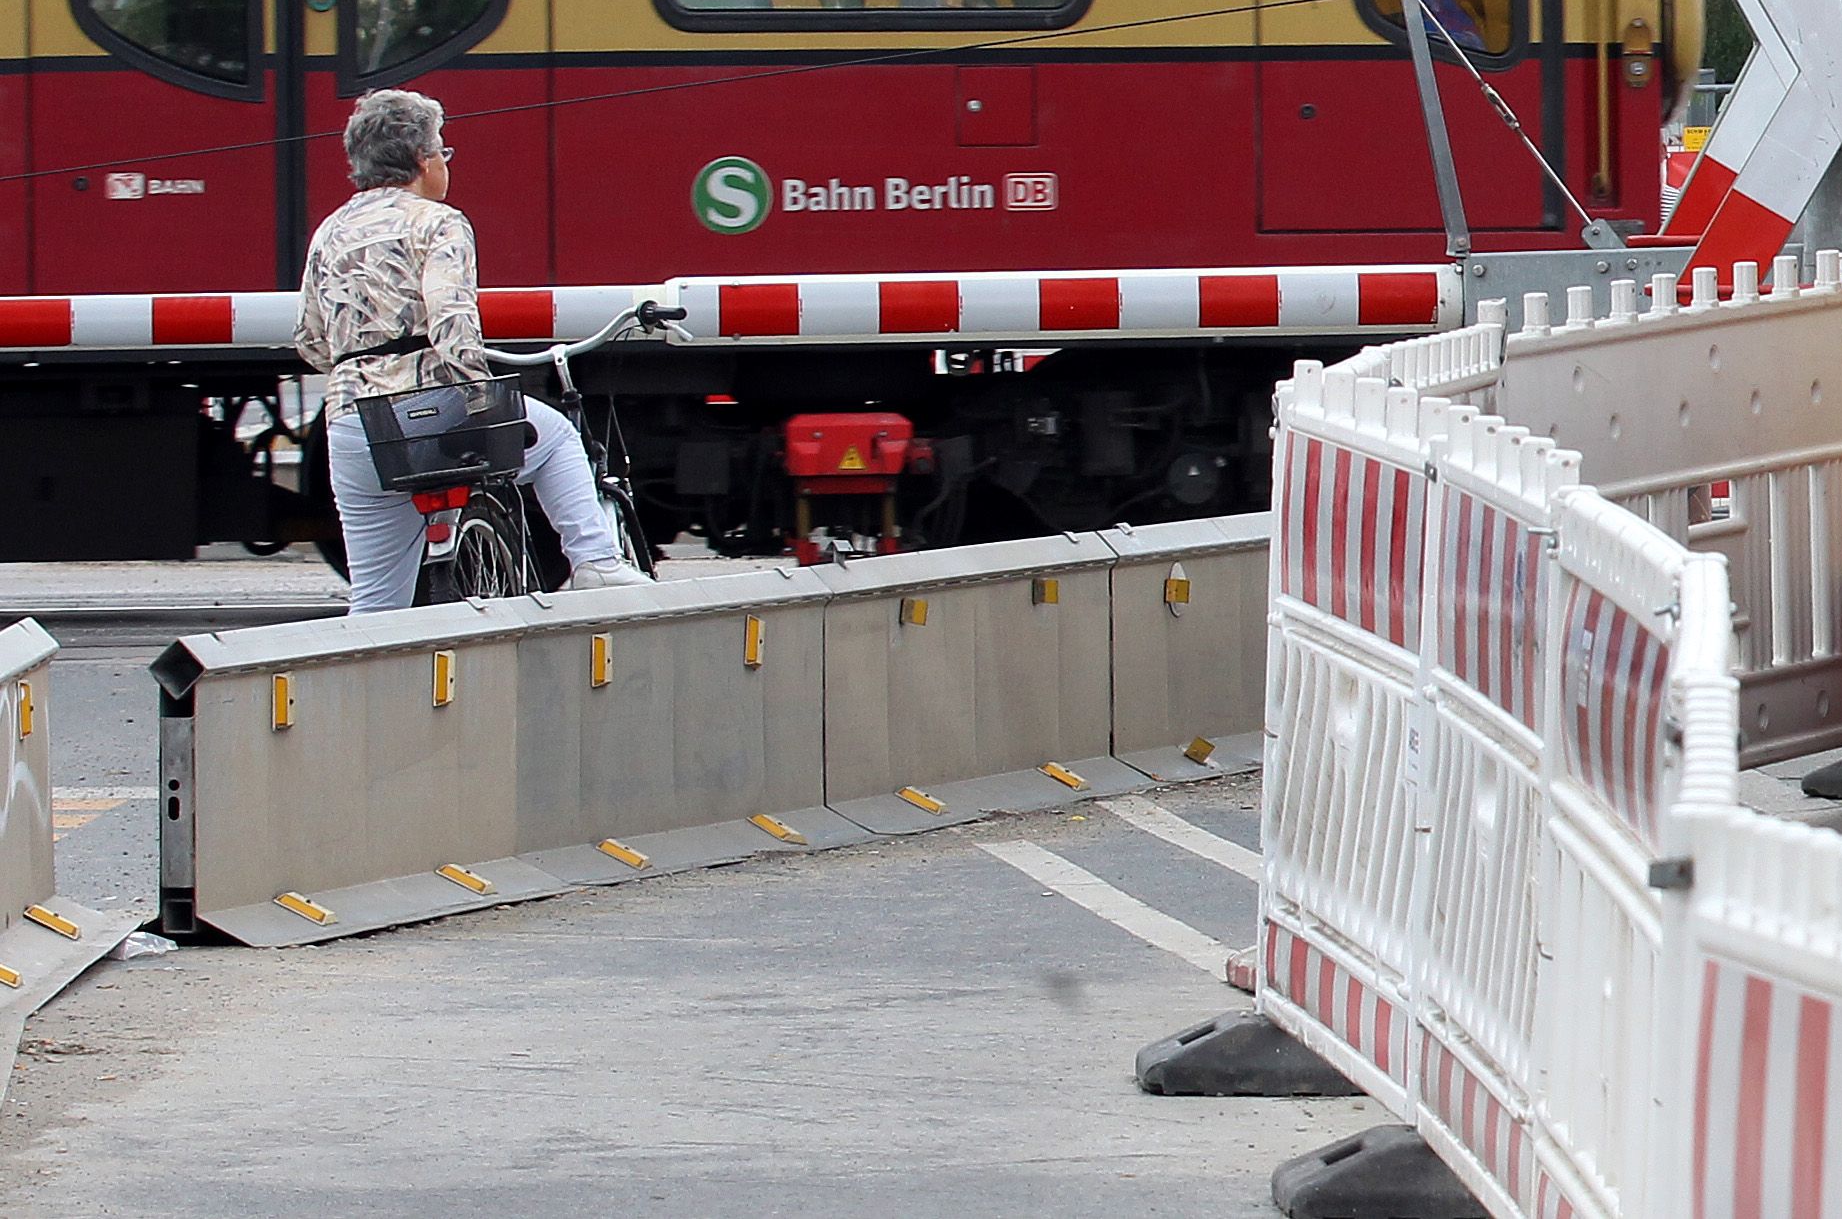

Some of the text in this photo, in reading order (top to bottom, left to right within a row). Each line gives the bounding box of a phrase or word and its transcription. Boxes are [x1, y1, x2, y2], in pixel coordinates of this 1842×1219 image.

[147, 179, 206, 194] BAHN
[706, 166, 1056, 227] S Bahn Berlin DB
